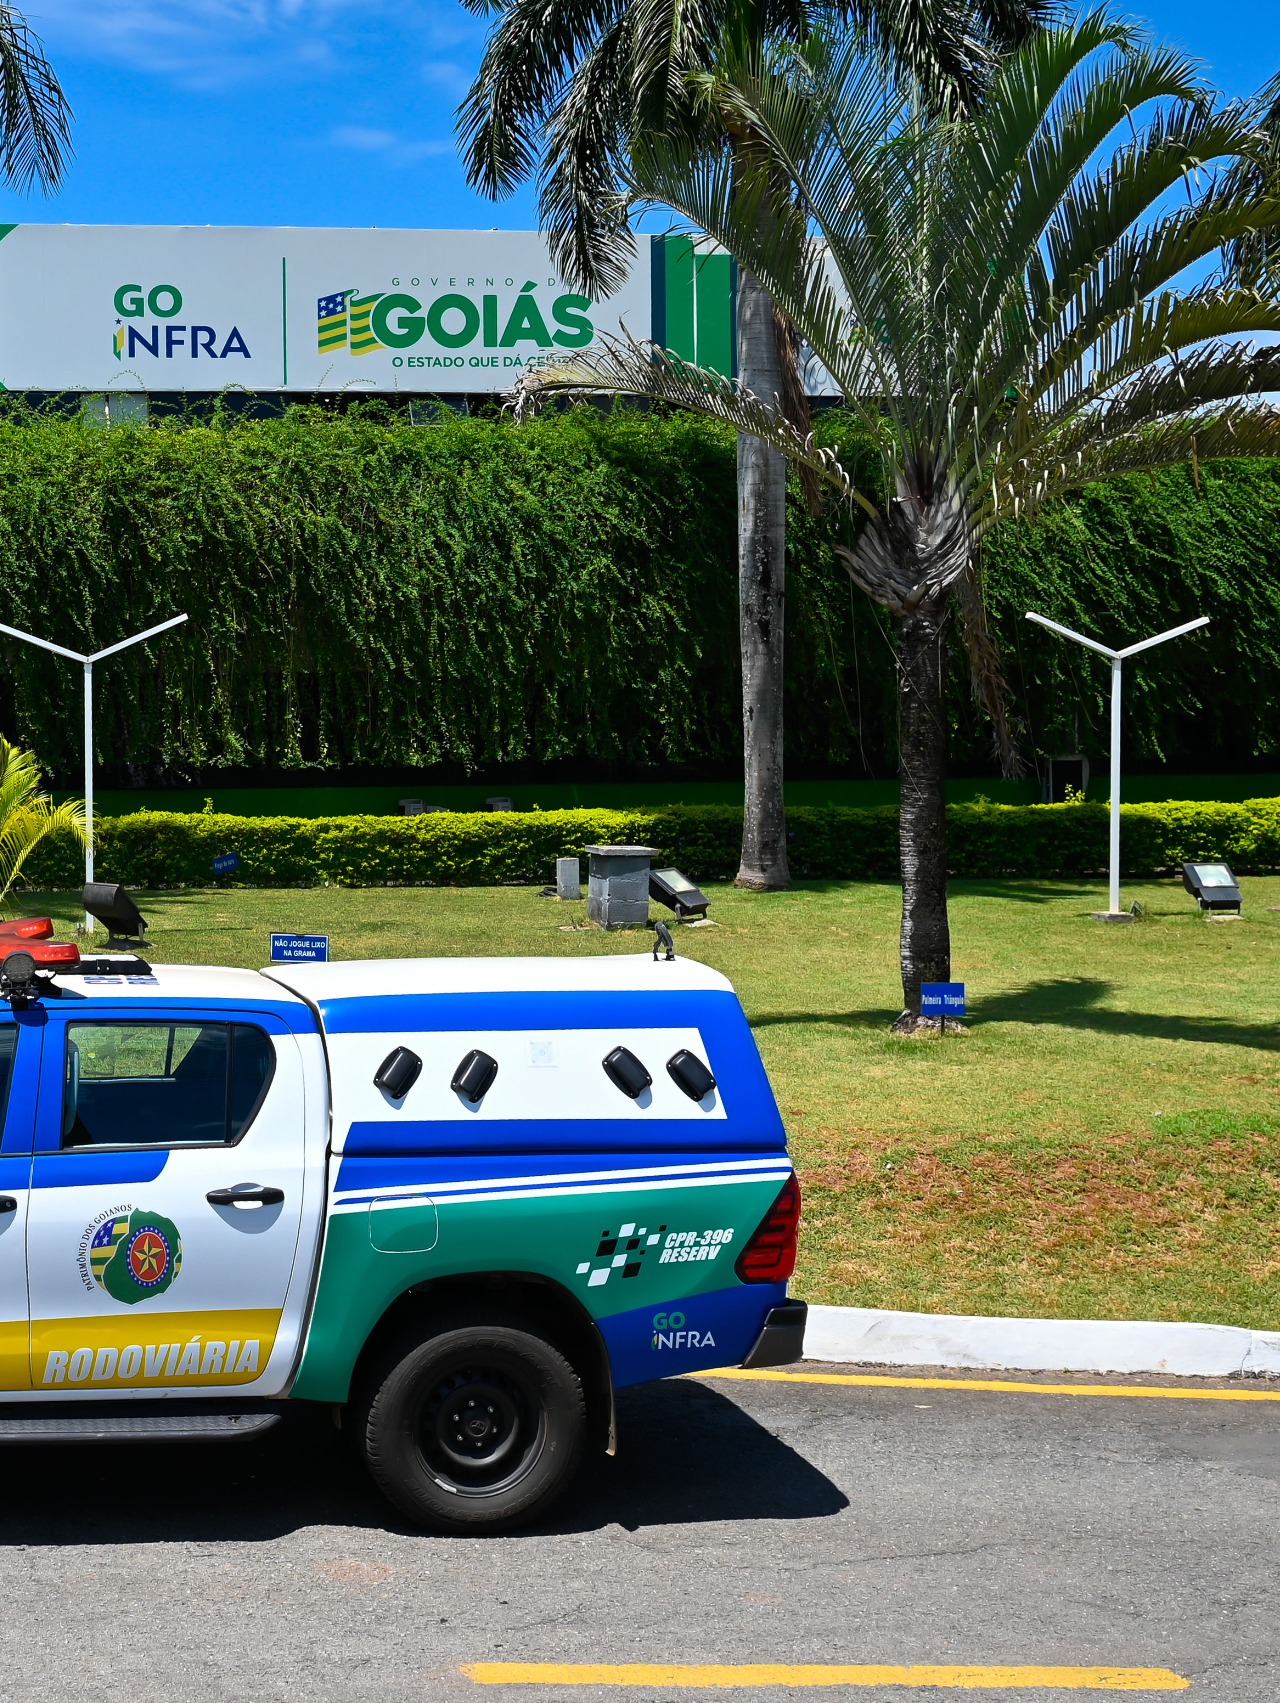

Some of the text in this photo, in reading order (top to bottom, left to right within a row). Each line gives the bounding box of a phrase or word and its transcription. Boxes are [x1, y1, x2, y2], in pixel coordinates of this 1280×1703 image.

[392, 277, 514, 287] GOVERNO
[113, 284, 183, 318] GO
[372, 280, 595, 349] GOIÁS
[392, 356, 404, 368] O
[407, 356, 465, 368] ESTADO
[468, 356, 499, 369] QUE
[503, 353, 523, 368] DÁ
[274, 938, 326, 949] NÃO JOGUE LIXO
[283, 949, 293, 957] NA
[75, 1203, 132, 1292] PATRIMÔNIO DOS GOIANOS
[664, 1227, 735, 1248] CPR-396
[658, 1244, 722, 1264] RESERV
[652, 1311, 686, 1330] GO
[42, 1335, 261, 1384] RODOVIÁRIA
